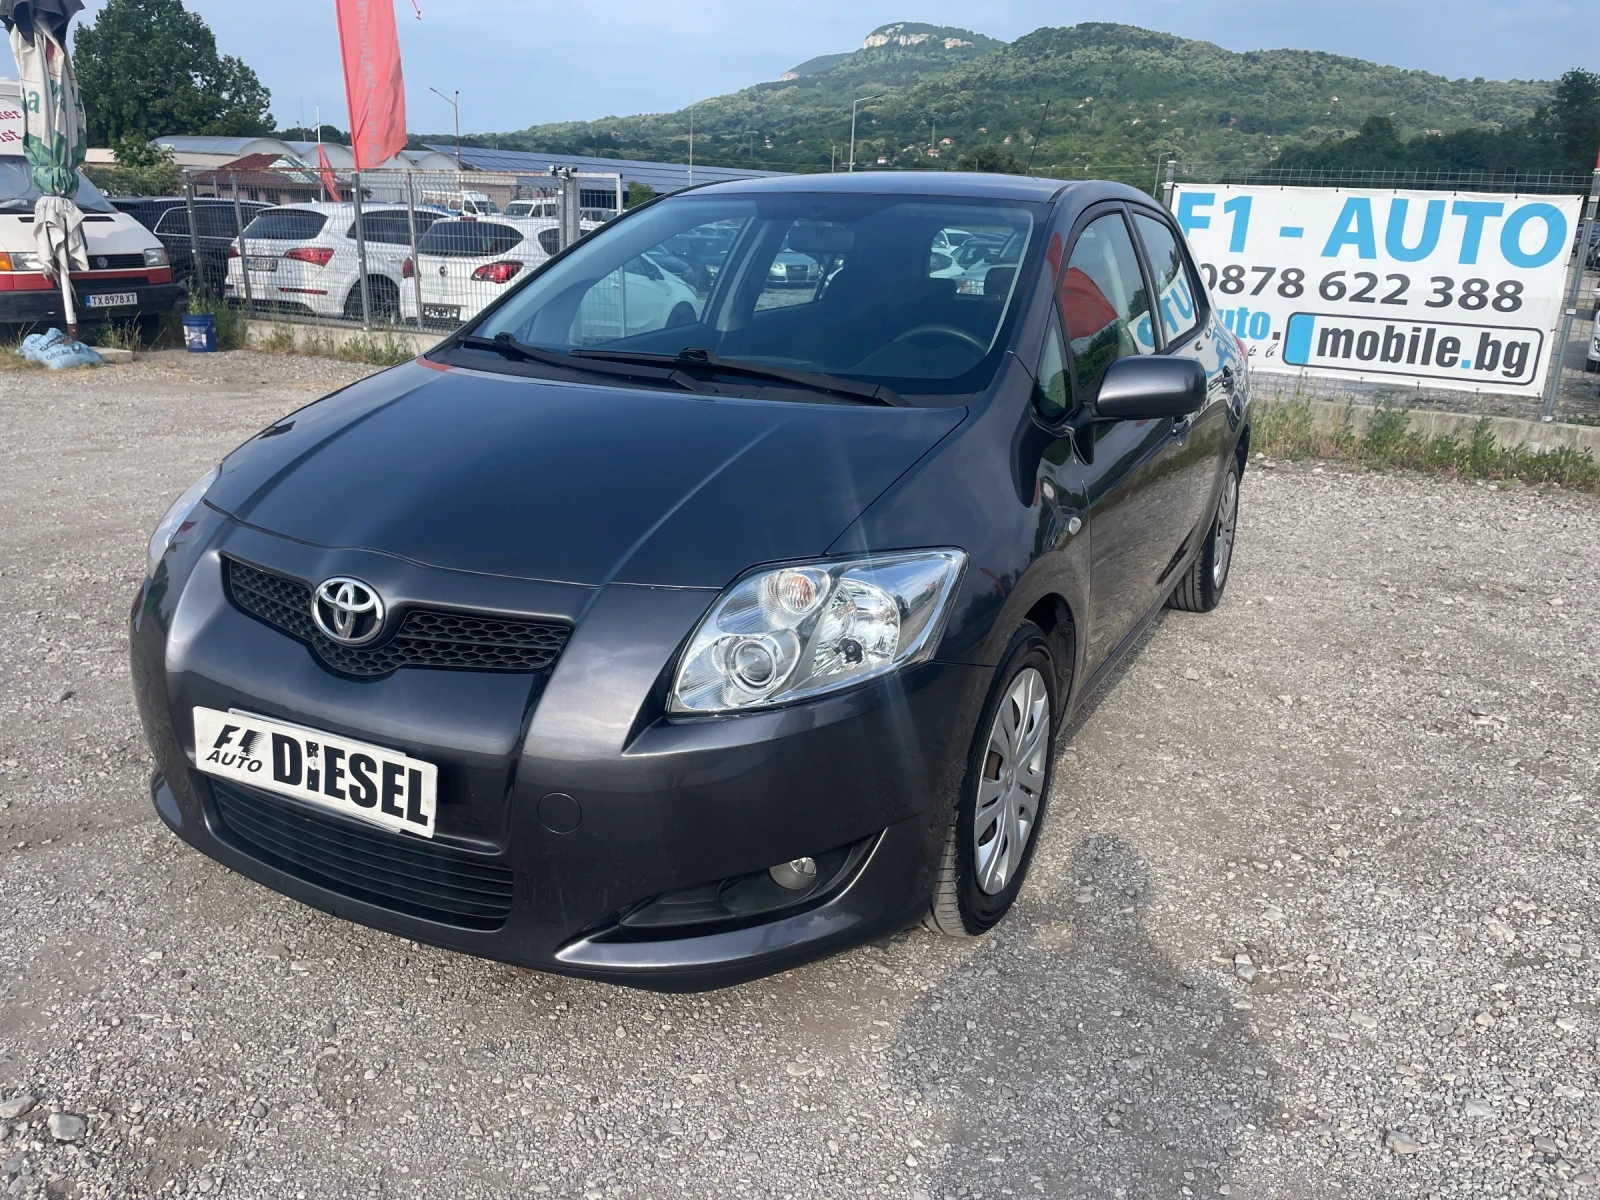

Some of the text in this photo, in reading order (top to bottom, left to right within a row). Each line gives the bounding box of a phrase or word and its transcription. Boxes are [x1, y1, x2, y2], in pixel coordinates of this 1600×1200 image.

[1177, 192, 1253, 253] F1
[1321, 197, 1568, 268] AUTO
[1319, 270, 1411, 305] 622
[1424, 276, 1524, 313] 388
[1316, 325, 1531, 378] mobile.bg
[206, 750, 263, 773] AUTO
[213, 724, 429, 827] F1 DIESEL
